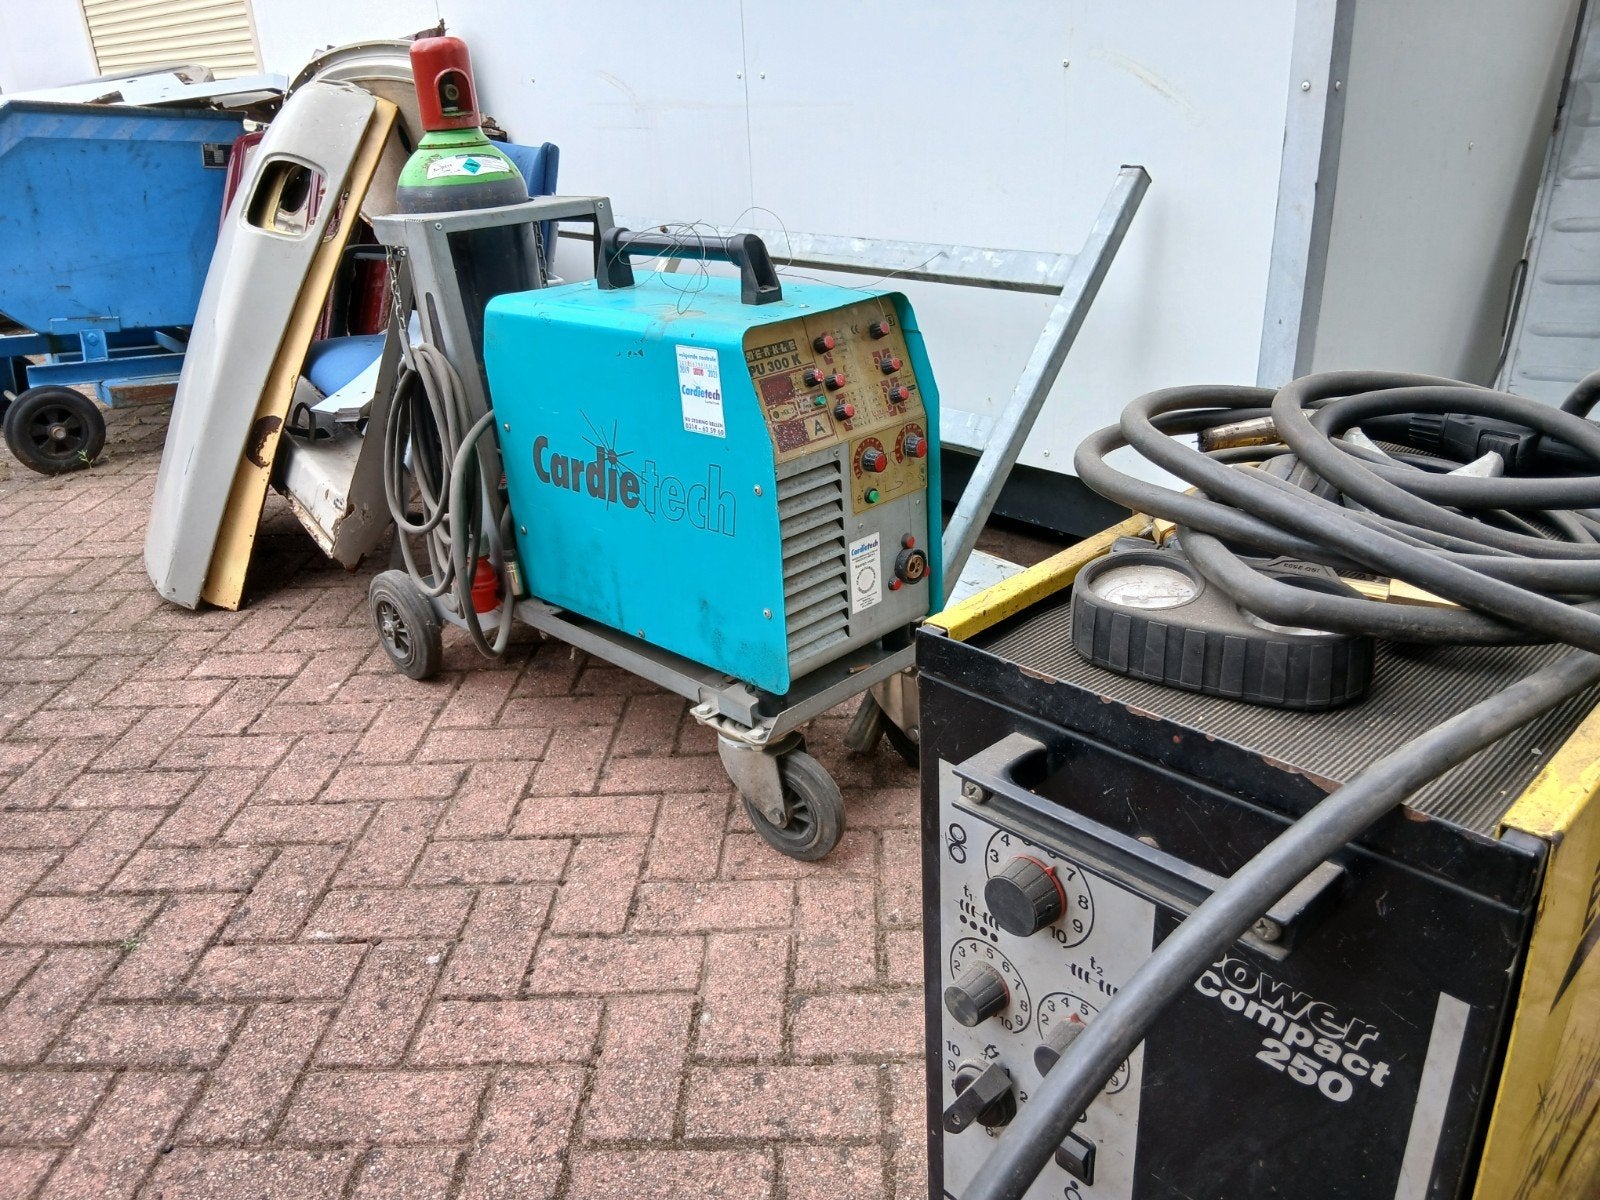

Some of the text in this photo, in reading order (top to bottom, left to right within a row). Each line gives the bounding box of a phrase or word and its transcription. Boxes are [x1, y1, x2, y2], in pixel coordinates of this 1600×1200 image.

[748, 353, 802, 376] PU 300 K
[681, 384, 721, 401] Cardietech
[814, 420, 826, 436] A
[533, 435, 736, 537] Cardietech
[851, 539, 879, 556] Cardietech
[990, 834, 1089, 944] 3 4 7 8 9 10
[953, 943, 1028, 1031] 2 3 4 5 6 7 8 9 10
[1041, 1013, 1049, 1026] 2
[1047, 1000, 1056, 1012] 3
[1061, 997, 1070, 1008] 4
[1080, 1003, 1089, 1016] 5
[1212, 953, 1380, 1051] ower
[946, 1040, 961, 1056] 10
[948, 1060, 956, 1072] 9
[1255, 1037, 1353, 1103] 250
[1020, 1090, 1028, 1103] 2
